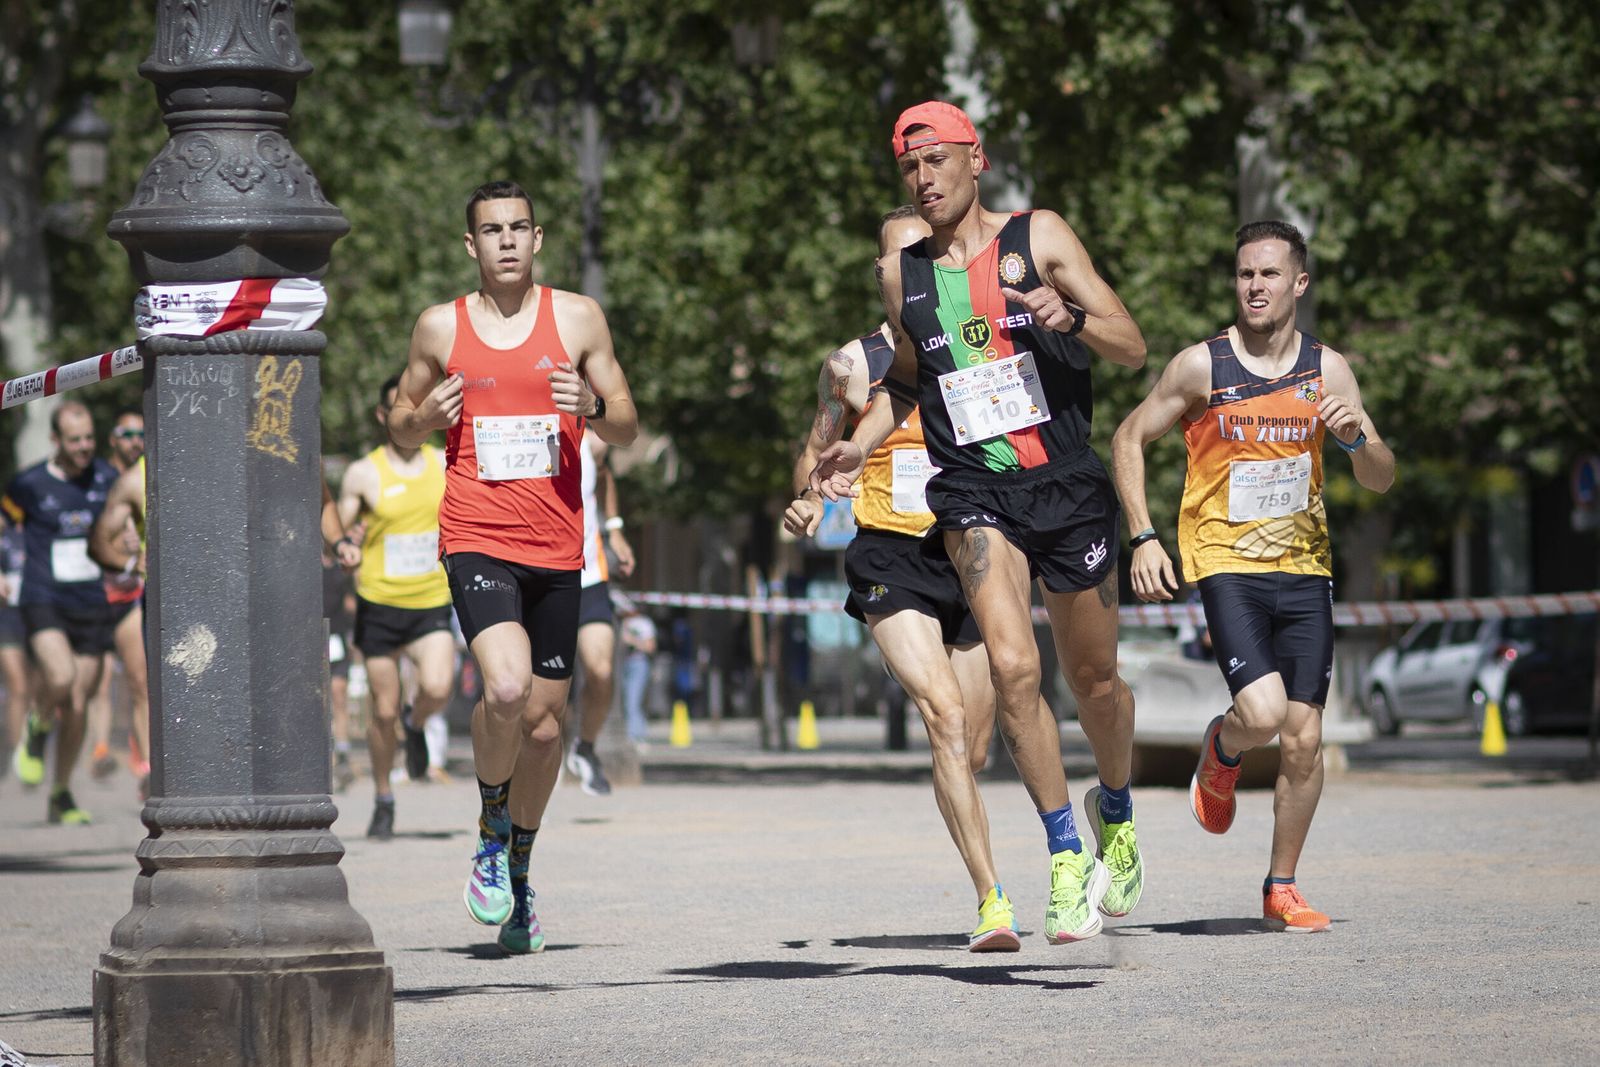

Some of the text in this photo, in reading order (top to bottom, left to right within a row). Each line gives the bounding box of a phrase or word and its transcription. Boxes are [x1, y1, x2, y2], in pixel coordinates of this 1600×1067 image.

[922, 333, 954, 351] LOKI
[947, 387, 970, 400] alsa
[996, 384, 1016, 393] asisa
[979, 400, 1020, 425] 110
[1229, 414, 1310, 427] Club Deportivo
[1218, 414, 1246, 442] LA
[478, 431, 500, 440] alsa
[502, 453, 537, 468] 127
[898, 464, 920, 472] alsa
[1235, 475, 1257, 484] alsa
[1257, 492, 1291, 509] 759
